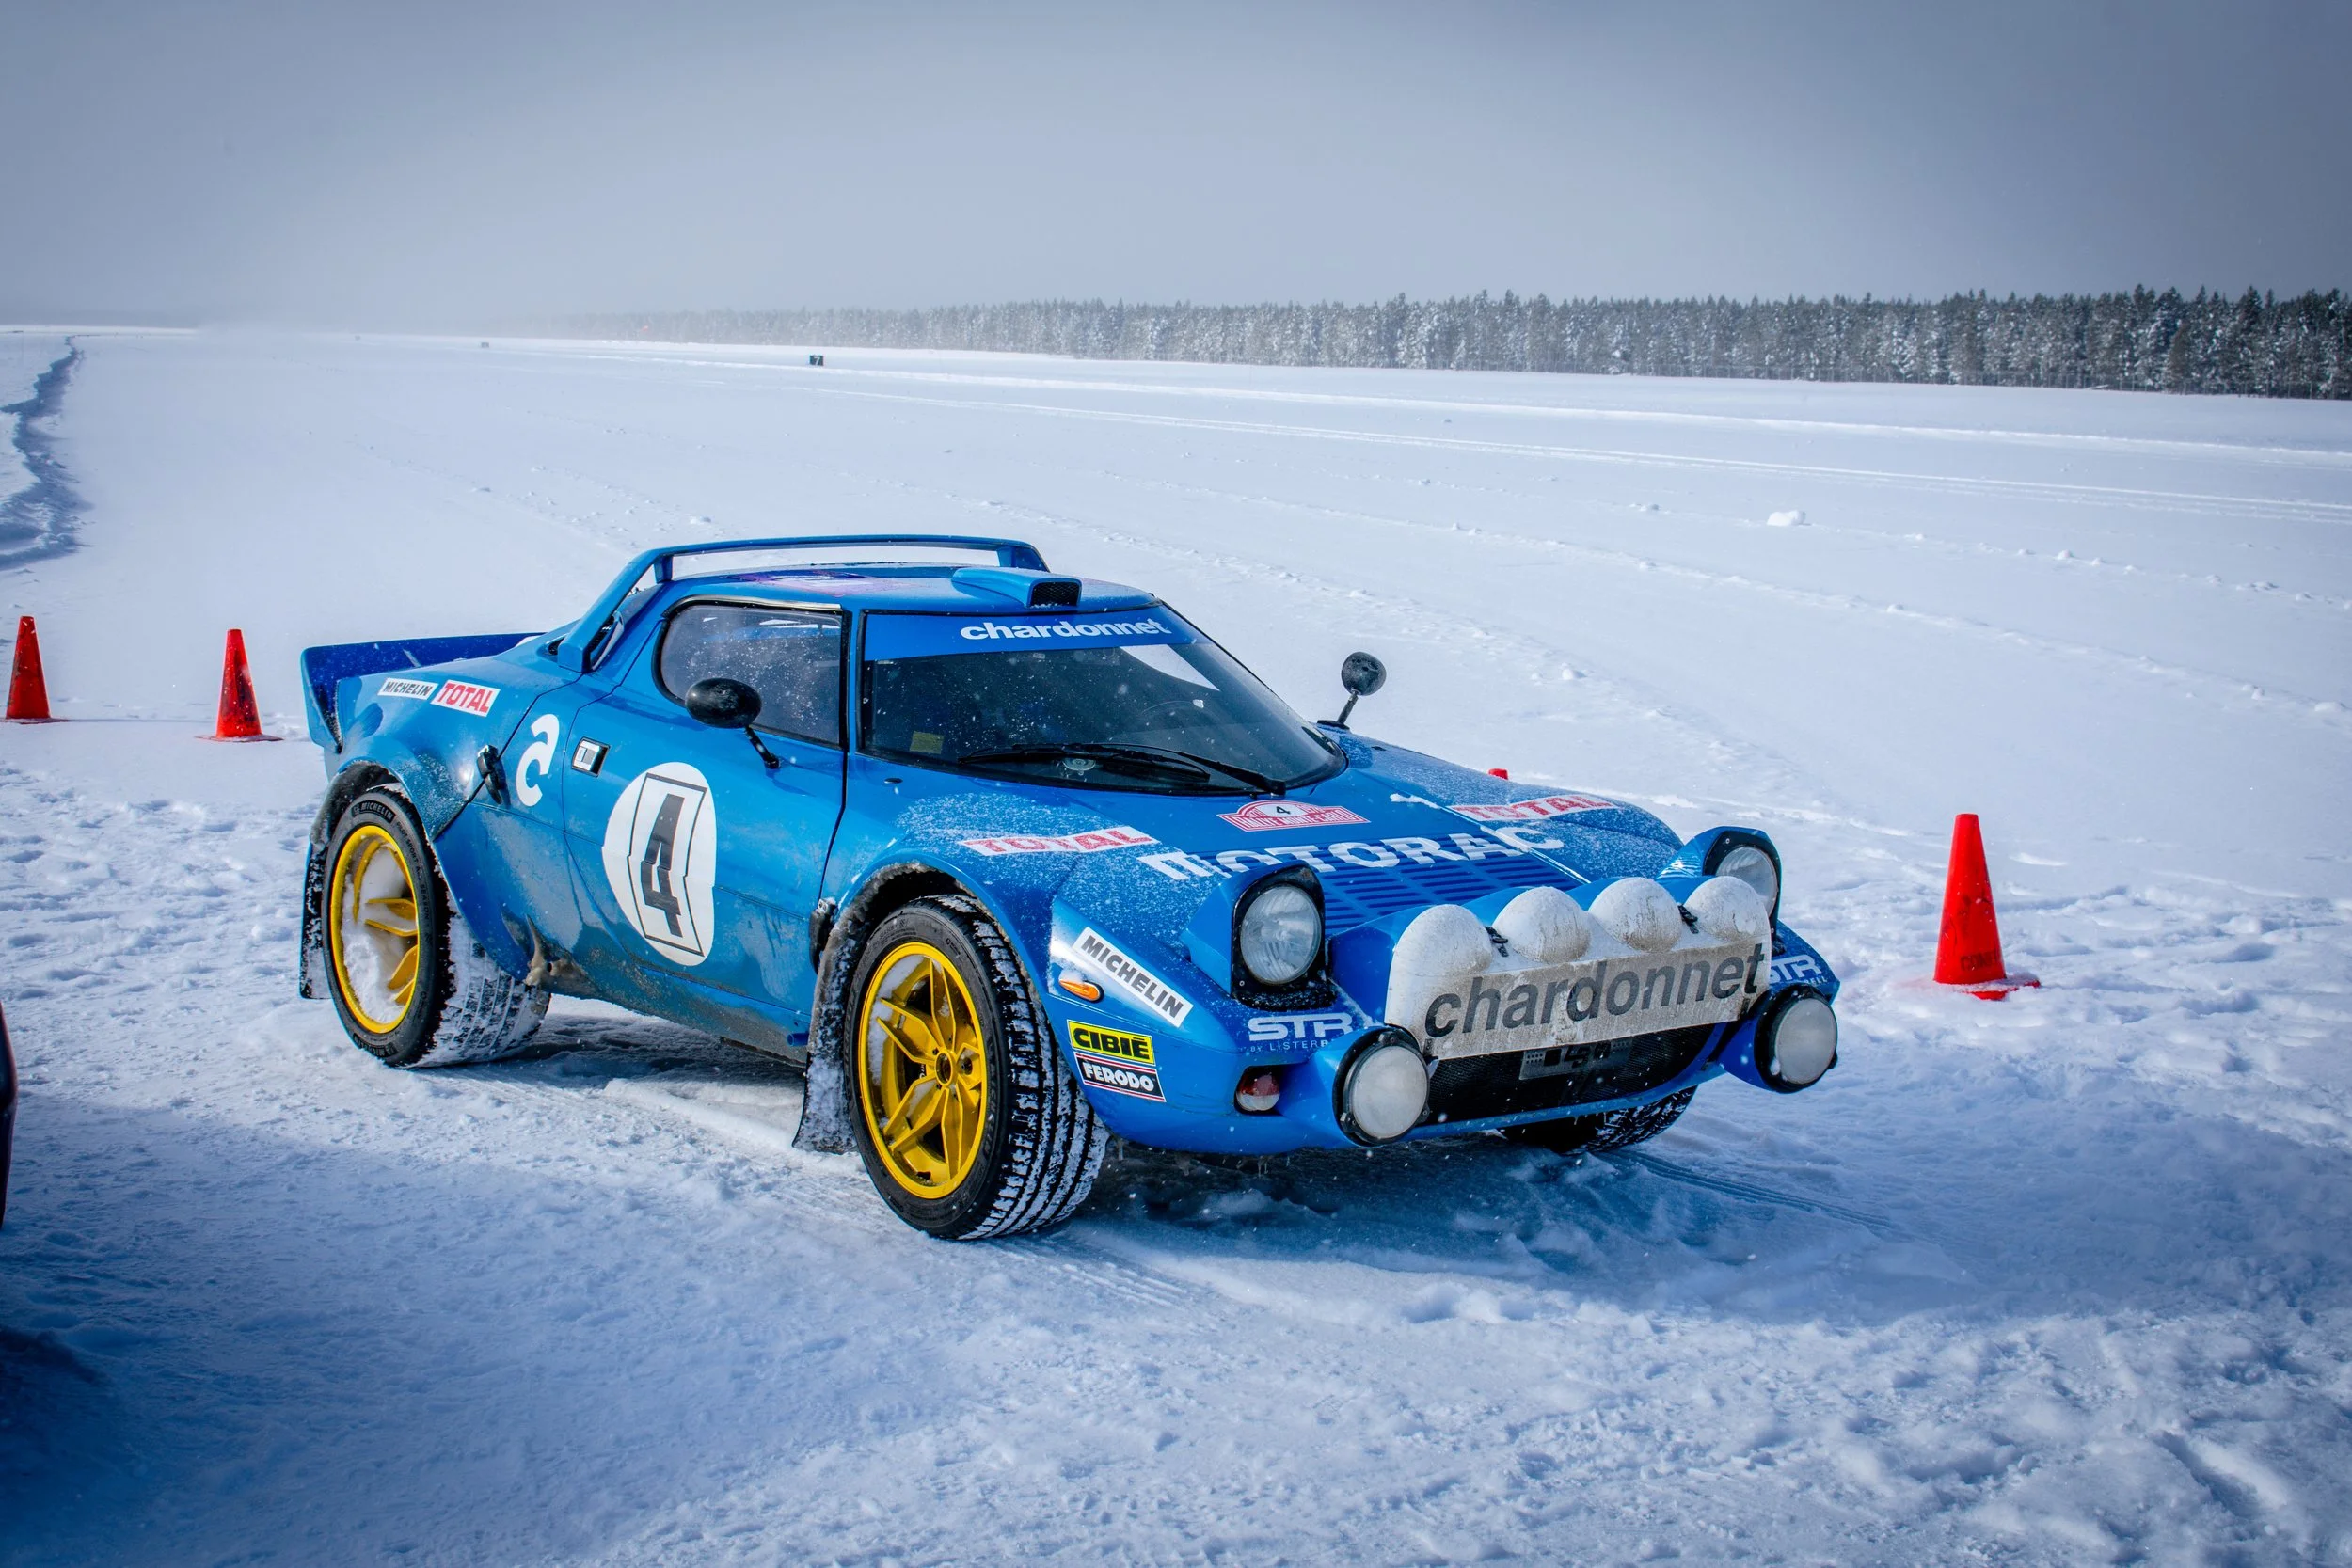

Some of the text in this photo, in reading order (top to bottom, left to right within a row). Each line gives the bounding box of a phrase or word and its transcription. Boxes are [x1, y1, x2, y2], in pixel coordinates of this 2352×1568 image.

[813, 356, 821, 367] 7
[961, 618, 1172, 641] chardonnet
[382, 681, 434, 698] MICHELIN
[437, 682, 493, 714] TOTAL
[1275, 805, 1291, 816] 4
[1452, 795, 1615, 819] TOTAL
[964, 830, 1153, 853] TOTAL
[1136, 827, 1564, 880] MOTORAC
[641, 793, 686, 939] 4
[1081, 935, 1184, 1019] MICHELIN
[1424, 943, 1765, 1037] chardonnet
[1248, 1012, 1353, 1041] STR
[1083, 1063, 1154, 1092] FERODO
